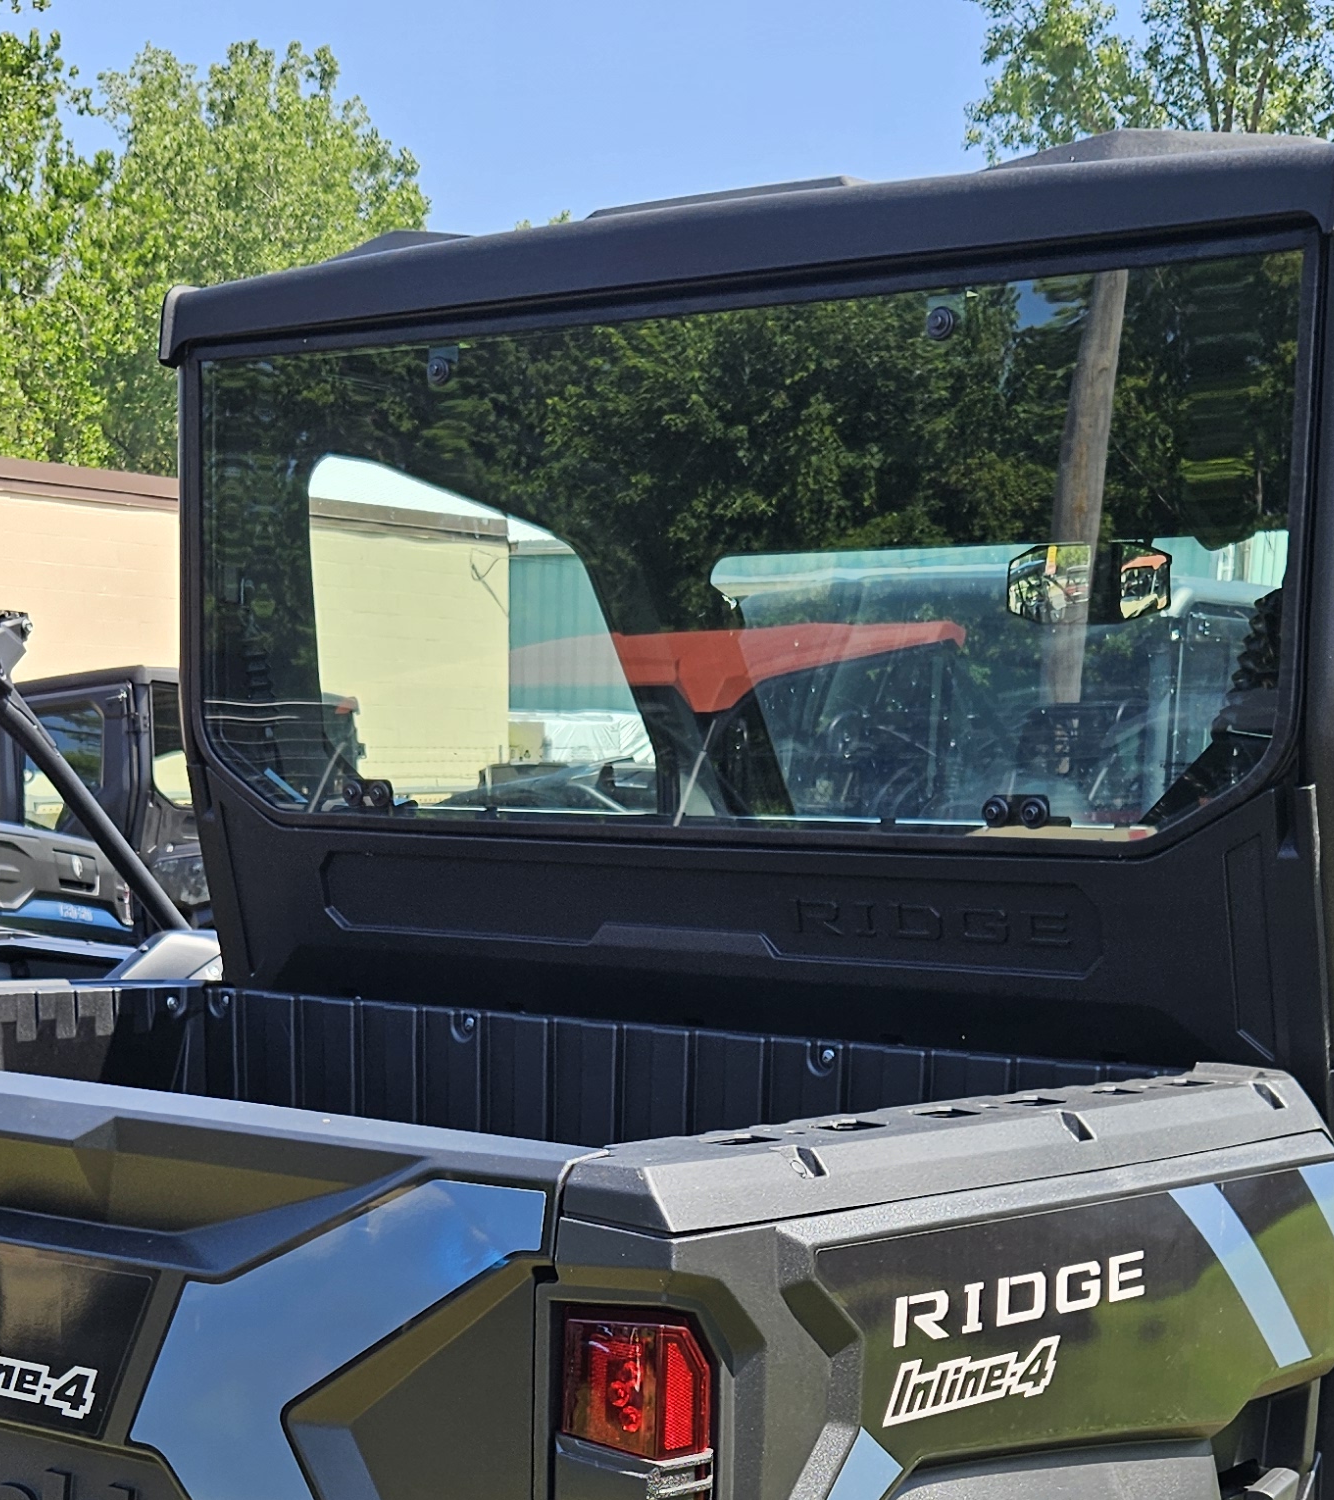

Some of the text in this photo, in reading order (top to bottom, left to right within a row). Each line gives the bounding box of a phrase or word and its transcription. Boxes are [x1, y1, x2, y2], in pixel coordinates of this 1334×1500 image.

[792, 899, 1070, 945] RIDGE
[893, 1250, 1145, 1348] RIDGE
[882, 1335, 1061, 1428] Inline-4
